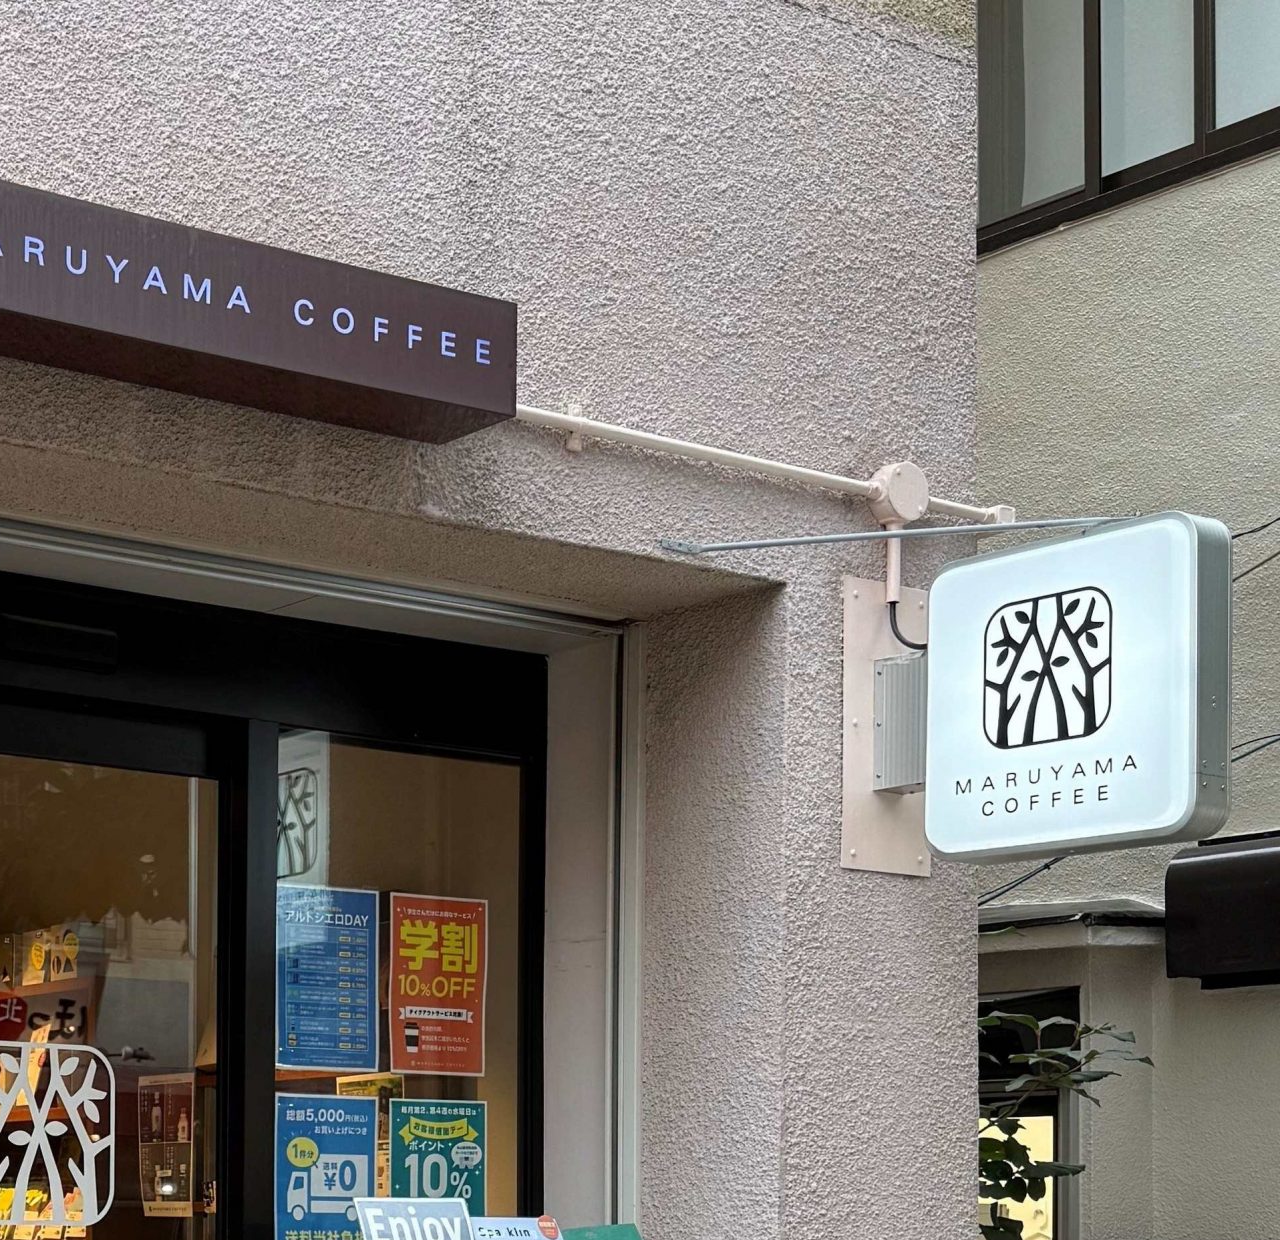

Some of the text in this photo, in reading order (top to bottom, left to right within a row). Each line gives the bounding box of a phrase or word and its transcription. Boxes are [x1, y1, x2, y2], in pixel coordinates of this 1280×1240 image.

[294, 298, 491, 365] COFFEE
[955, 754, 1138, 796] MARUYAMA
[981, 785, 1109, 817] COFFEE
[285, 911, 369, 927] アルトシエロDAY
[398, 919, 479, 974] 学割
[398, 974, 476, 999] 10%OFF
[409, 1140, 445, 1152] ポイント
[323, 1160, 357, 1192] ¥0
[404, 1153, 472, 1199] 10%
